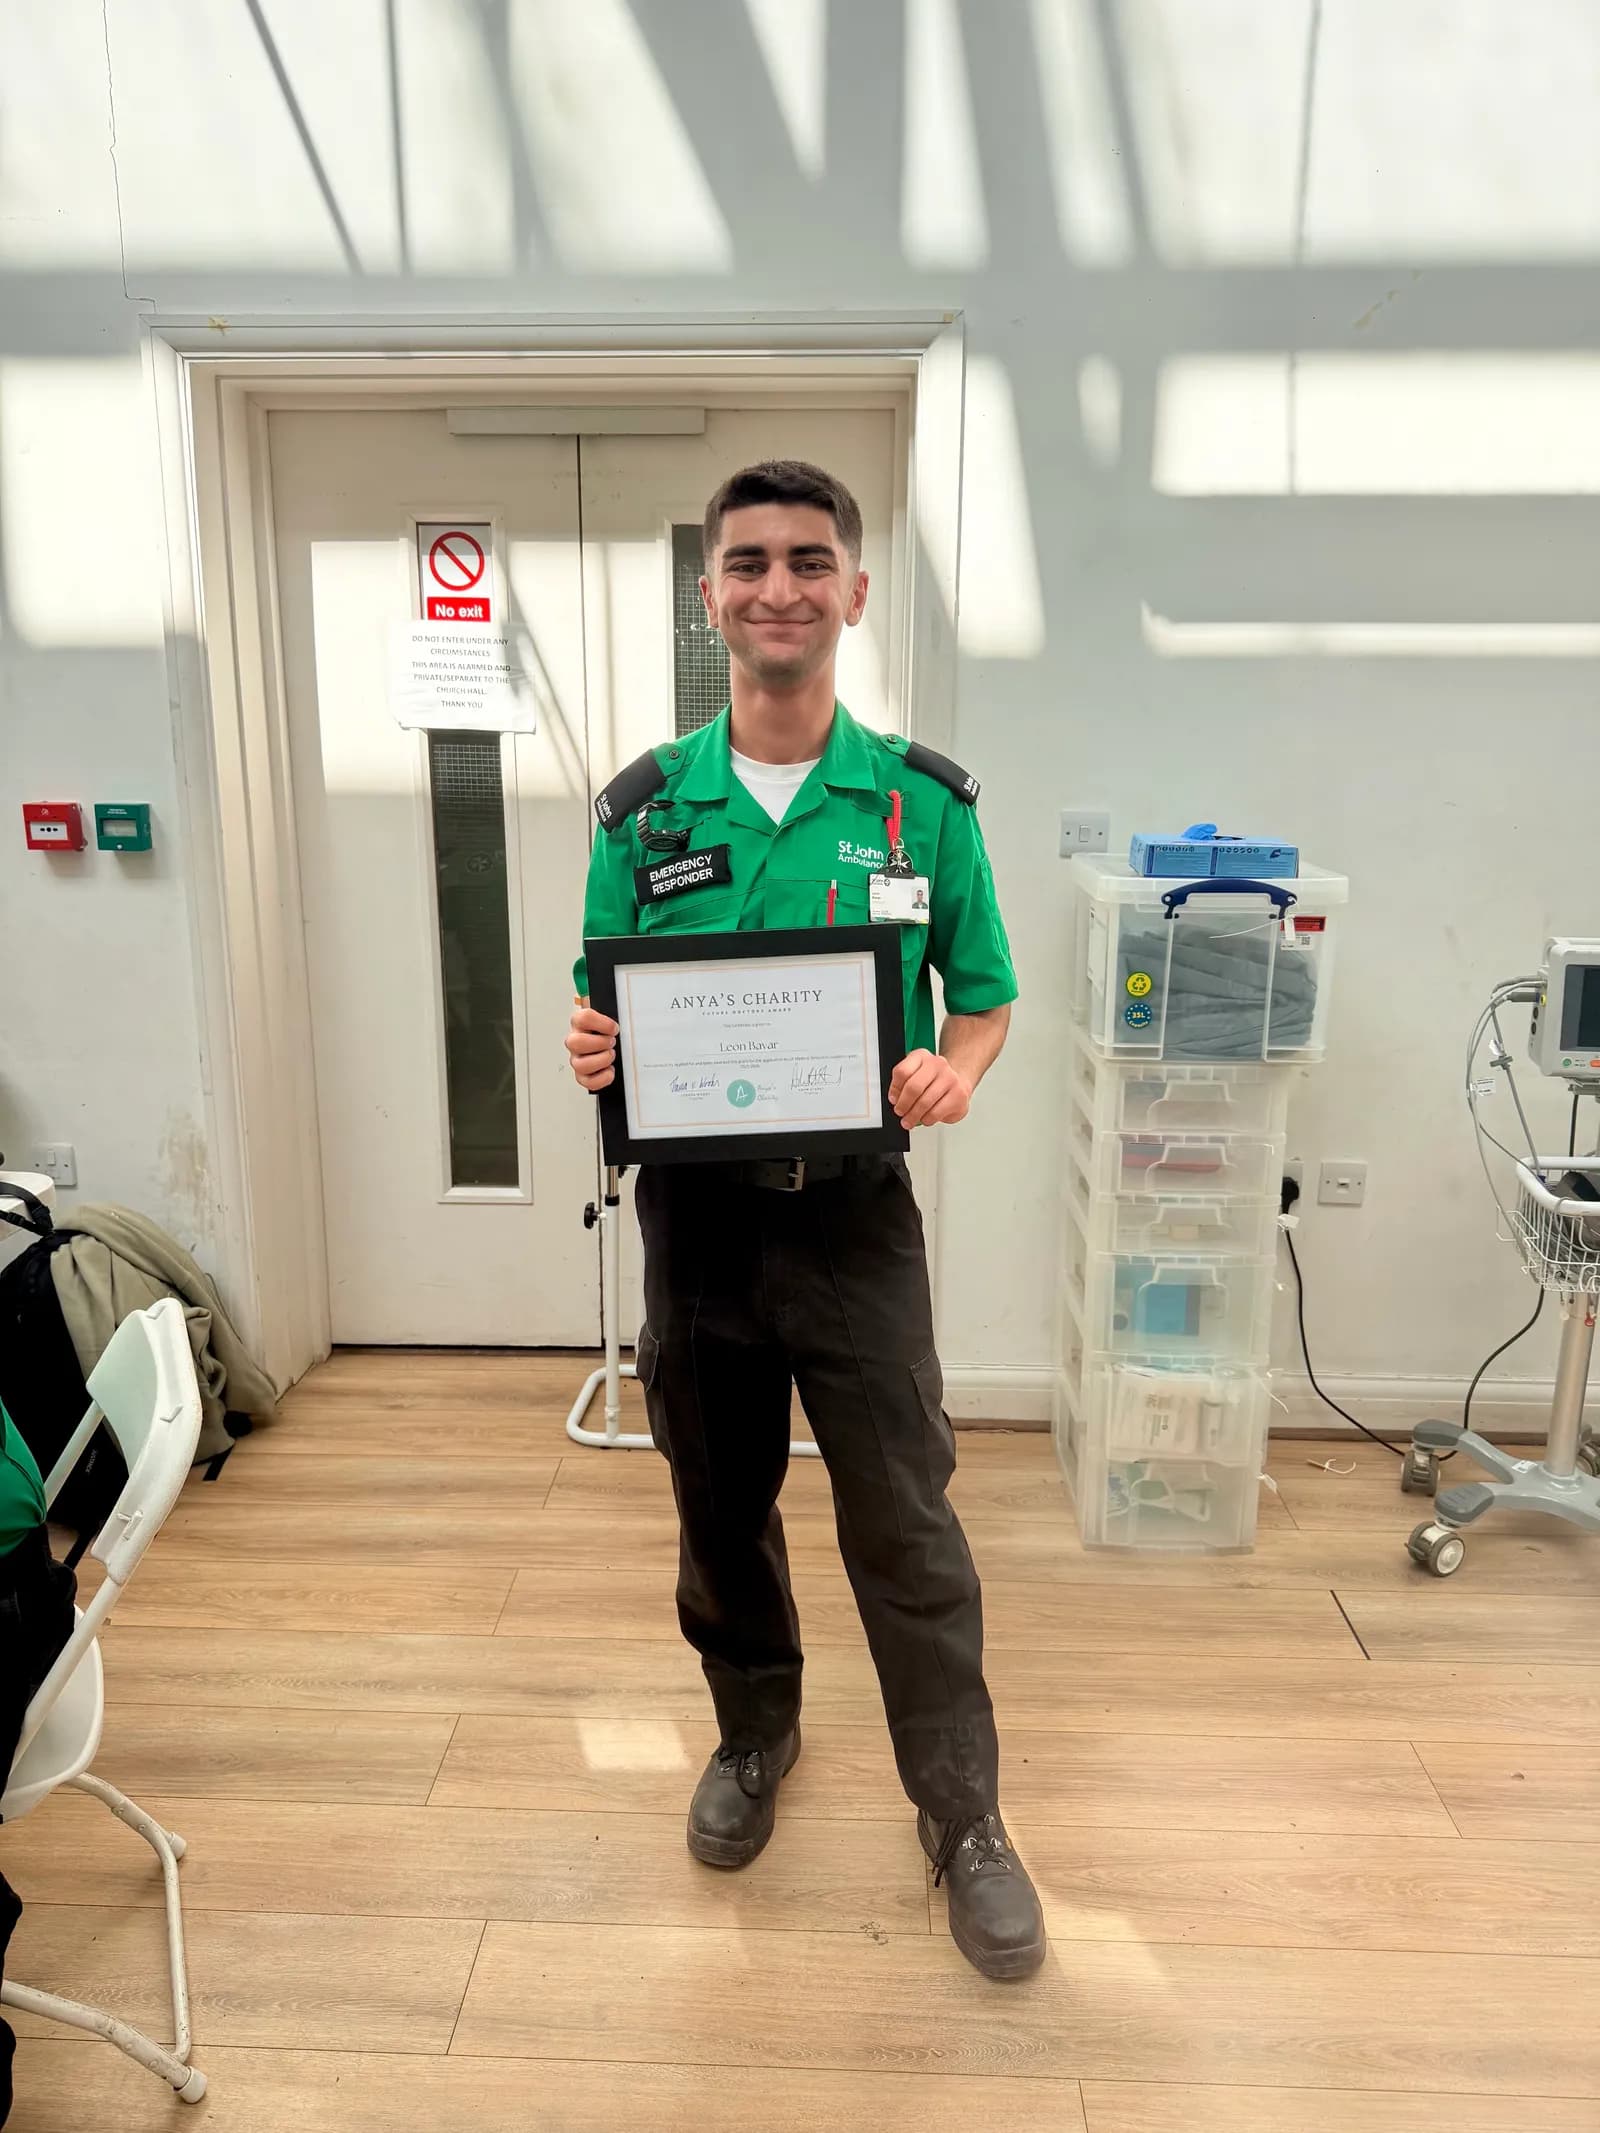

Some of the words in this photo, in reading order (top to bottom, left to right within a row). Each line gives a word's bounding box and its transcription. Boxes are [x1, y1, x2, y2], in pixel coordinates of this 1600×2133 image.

[435, 604, 455, 617] No
[458, 604, 483, 618] exit
[425, 635, 440, 643] NOT
[442, 636, 465, 644] ENTER
[466, 637, 492, 645] UNDER
[493, 638, 509, 646] ANY
[430, 648, 491, 657] CIRCUMSTANCES
[458, 663, 493, 671] ALARMED
[413, 674, 482, 683] PRIVATE/SEPARATE
[441, 700, 466, 708] THANK
[467, 701, 483, 709] YOU
[838, 840, 853, 854] St
[854, 843, 884, 861] John
[649, 854, 712, 882] EMERGENCY
[652, 867, 714, 896] RESPONDER
[743, 990, 823, 1006] CHARITY
